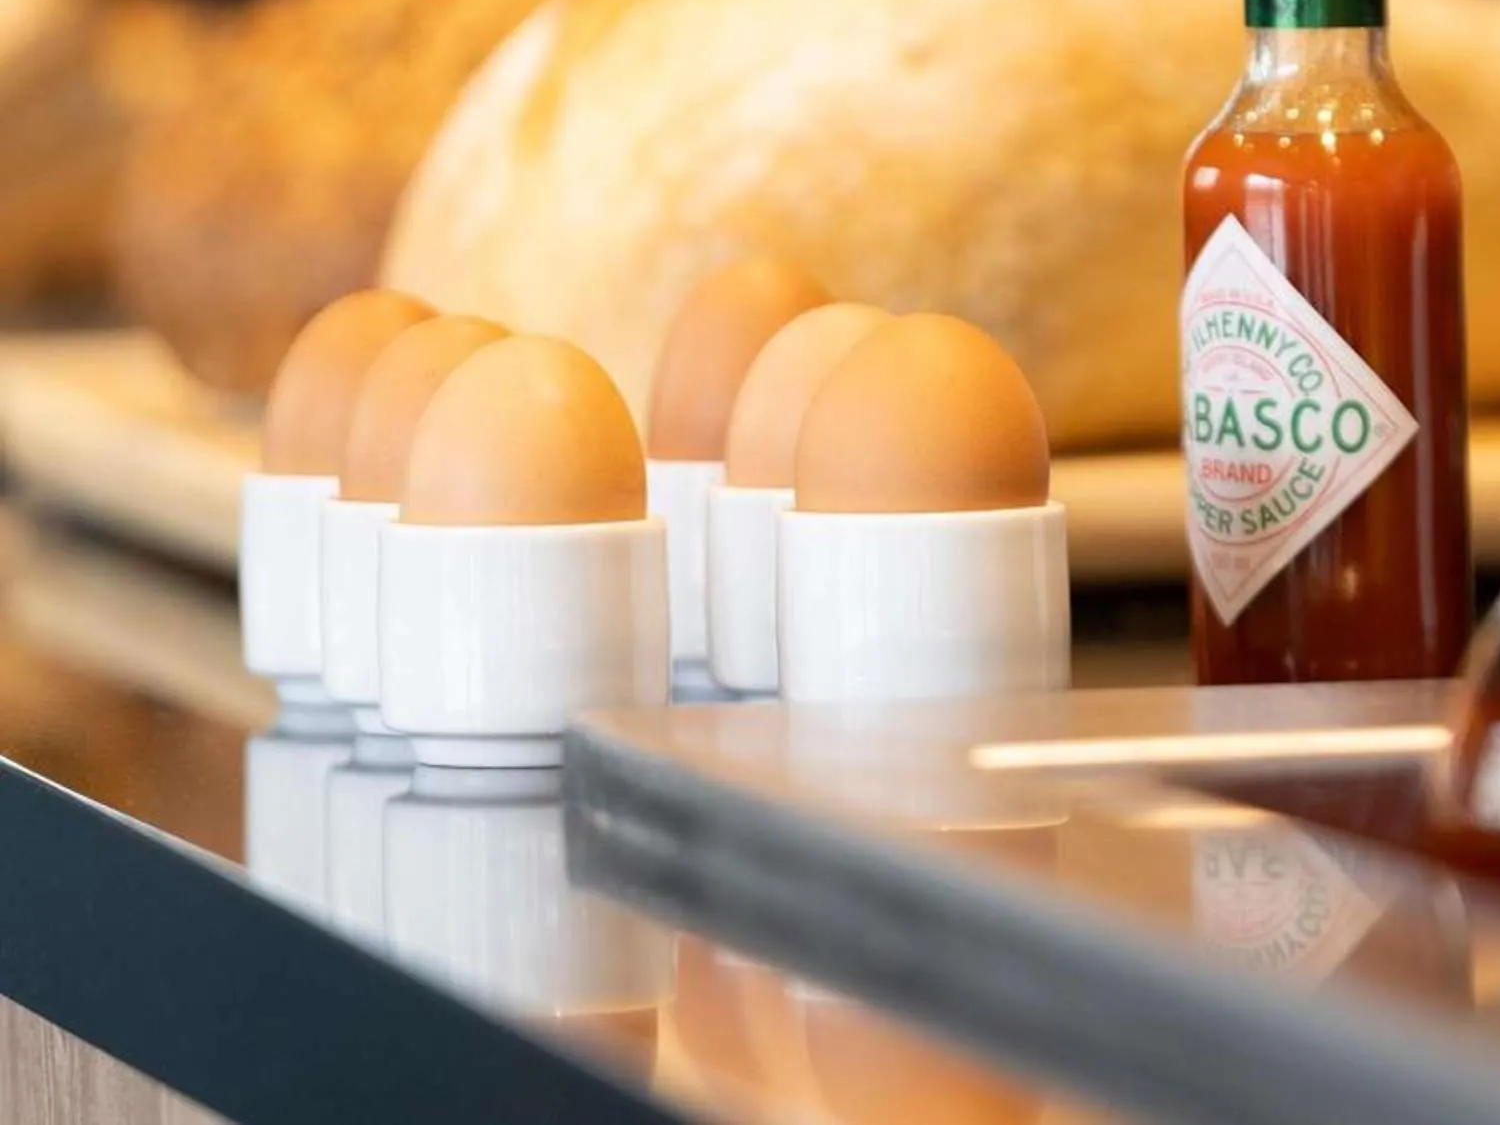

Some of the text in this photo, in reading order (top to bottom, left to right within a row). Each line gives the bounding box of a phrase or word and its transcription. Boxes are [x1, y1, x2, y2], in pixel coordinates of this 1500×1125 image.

[1187, 392, 1371, 454] BASCO
[1201, 457, 1273, 487] BRAND
[1240, 457, 1325, 536] SAUCE
